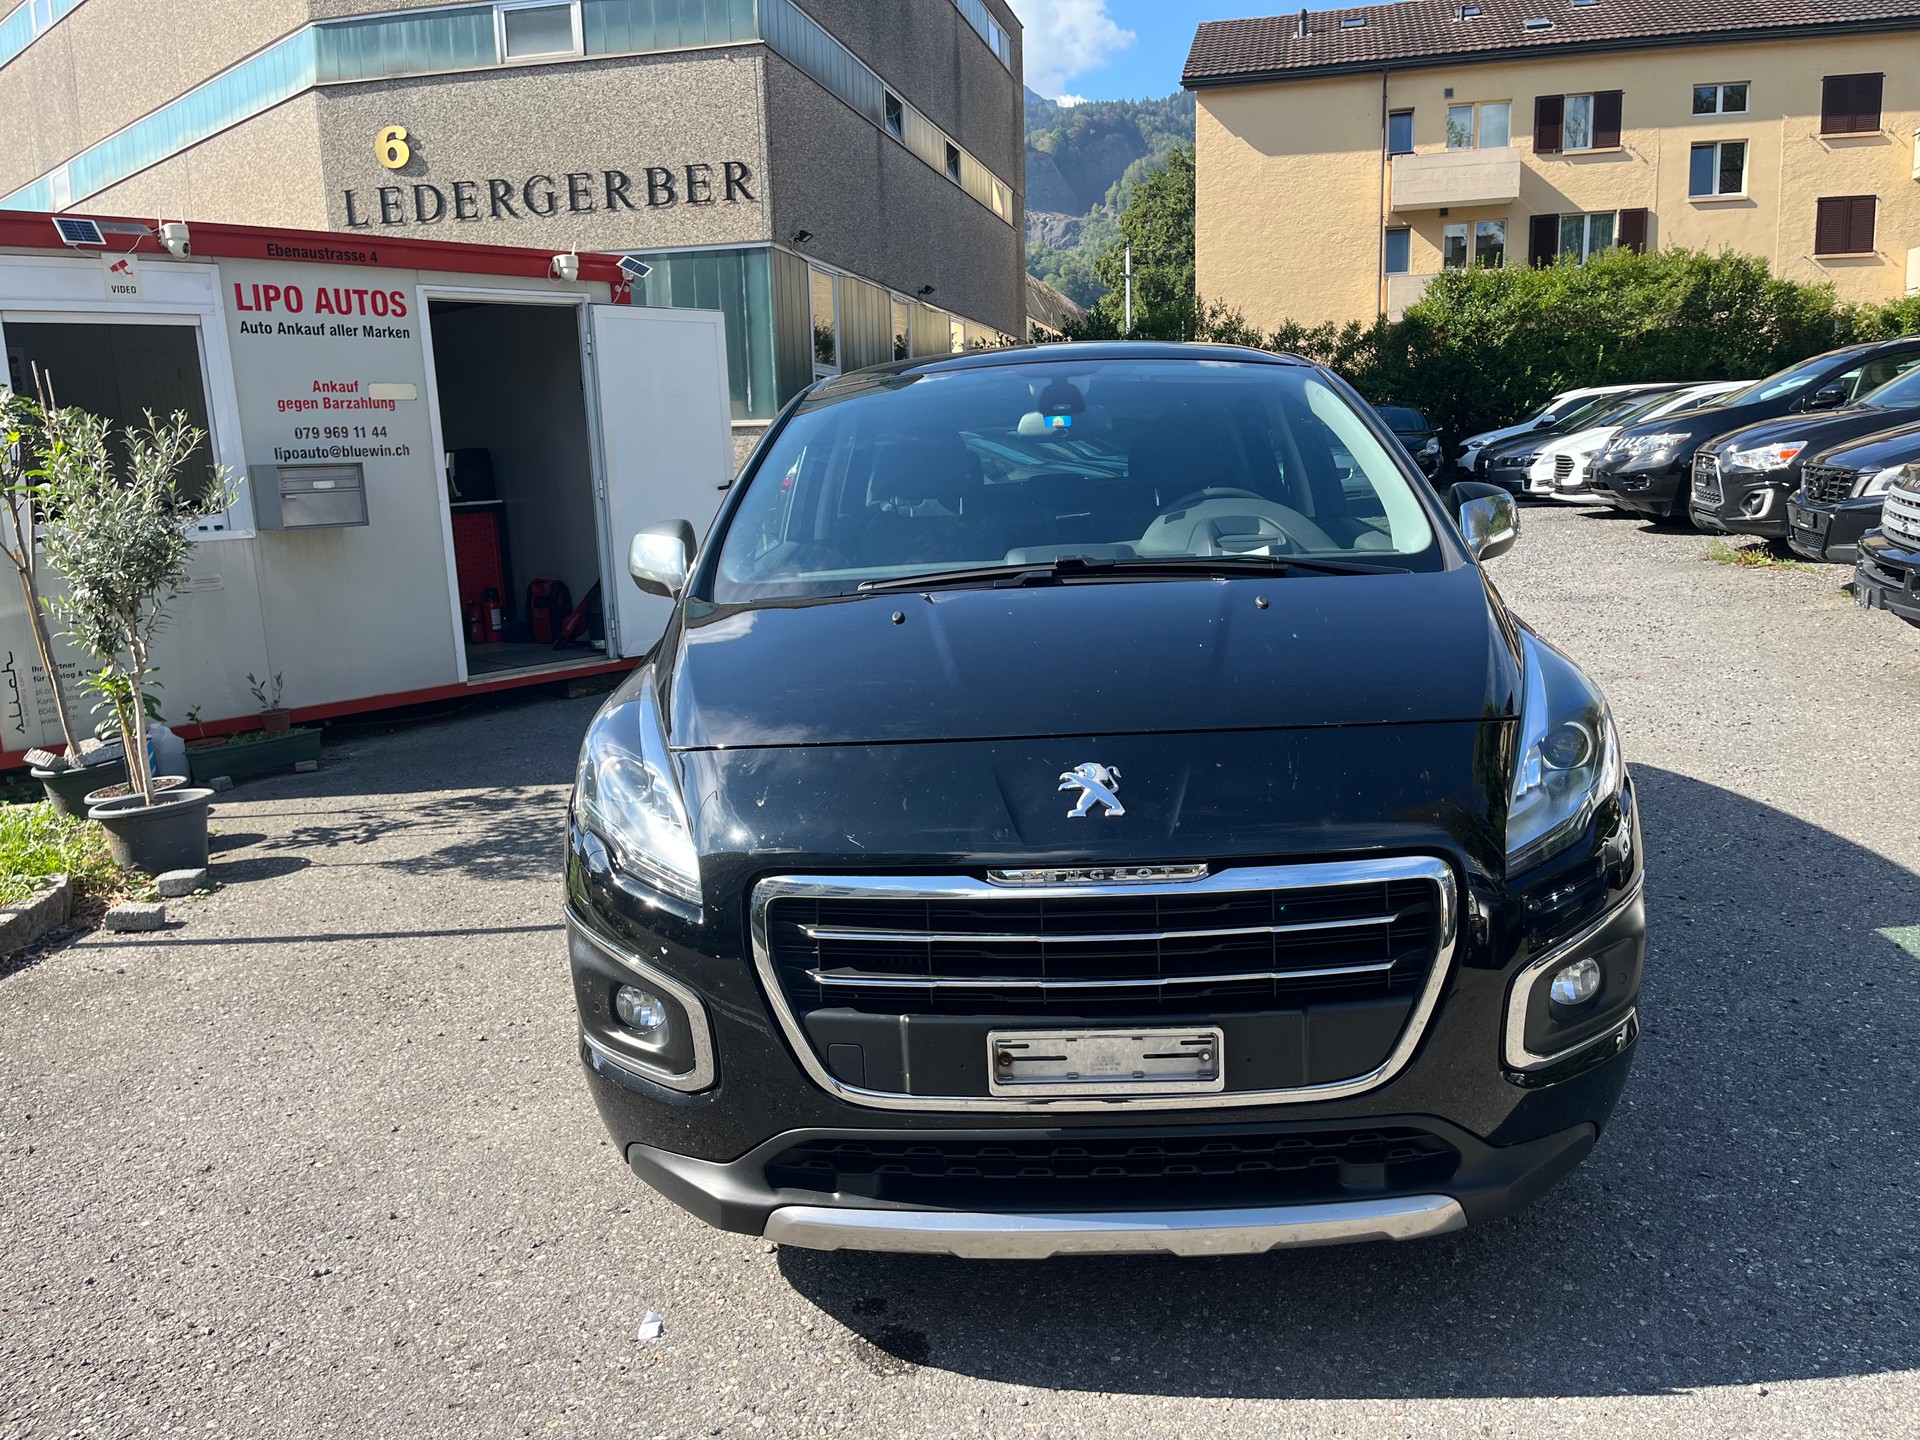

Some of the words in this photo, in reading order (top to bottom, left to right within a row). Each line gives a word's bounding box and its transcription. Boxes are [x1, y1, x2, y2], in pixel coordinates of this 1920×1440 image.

[375, 125, 410, 169] 6
[343, 161, 757, 227] LEDERGERBER
[266, 243, 366, 262] Ebenaustrasse
[370, 251, 378, 263] 4
[111, 285, 137, 294] VIDEO
[234, 283, 303, 313] LIPO
[315, 287, 407, 318] AUTOS
[240, 321, 272, 334] Auto
[277, 322, 325, 336] Ankauf
[329, 324, 358, 337] aller
[363, 325, 410, 339] Marken
[312, 380, 359, 393] Ankauf
[277, 399, 318, 412] gegen
[322, 397, 396, 411] Barzahlung
[294, 427, 320, 439] 079
[324, 426, 349, 439] 969
[354, 426, 366, 438] 11
[372, 426, 388, 438] 44
[274, 444, 410, 462] lipoauto@bluewin.ch
[1021, 867, 1175, 881] PEUGEOT
